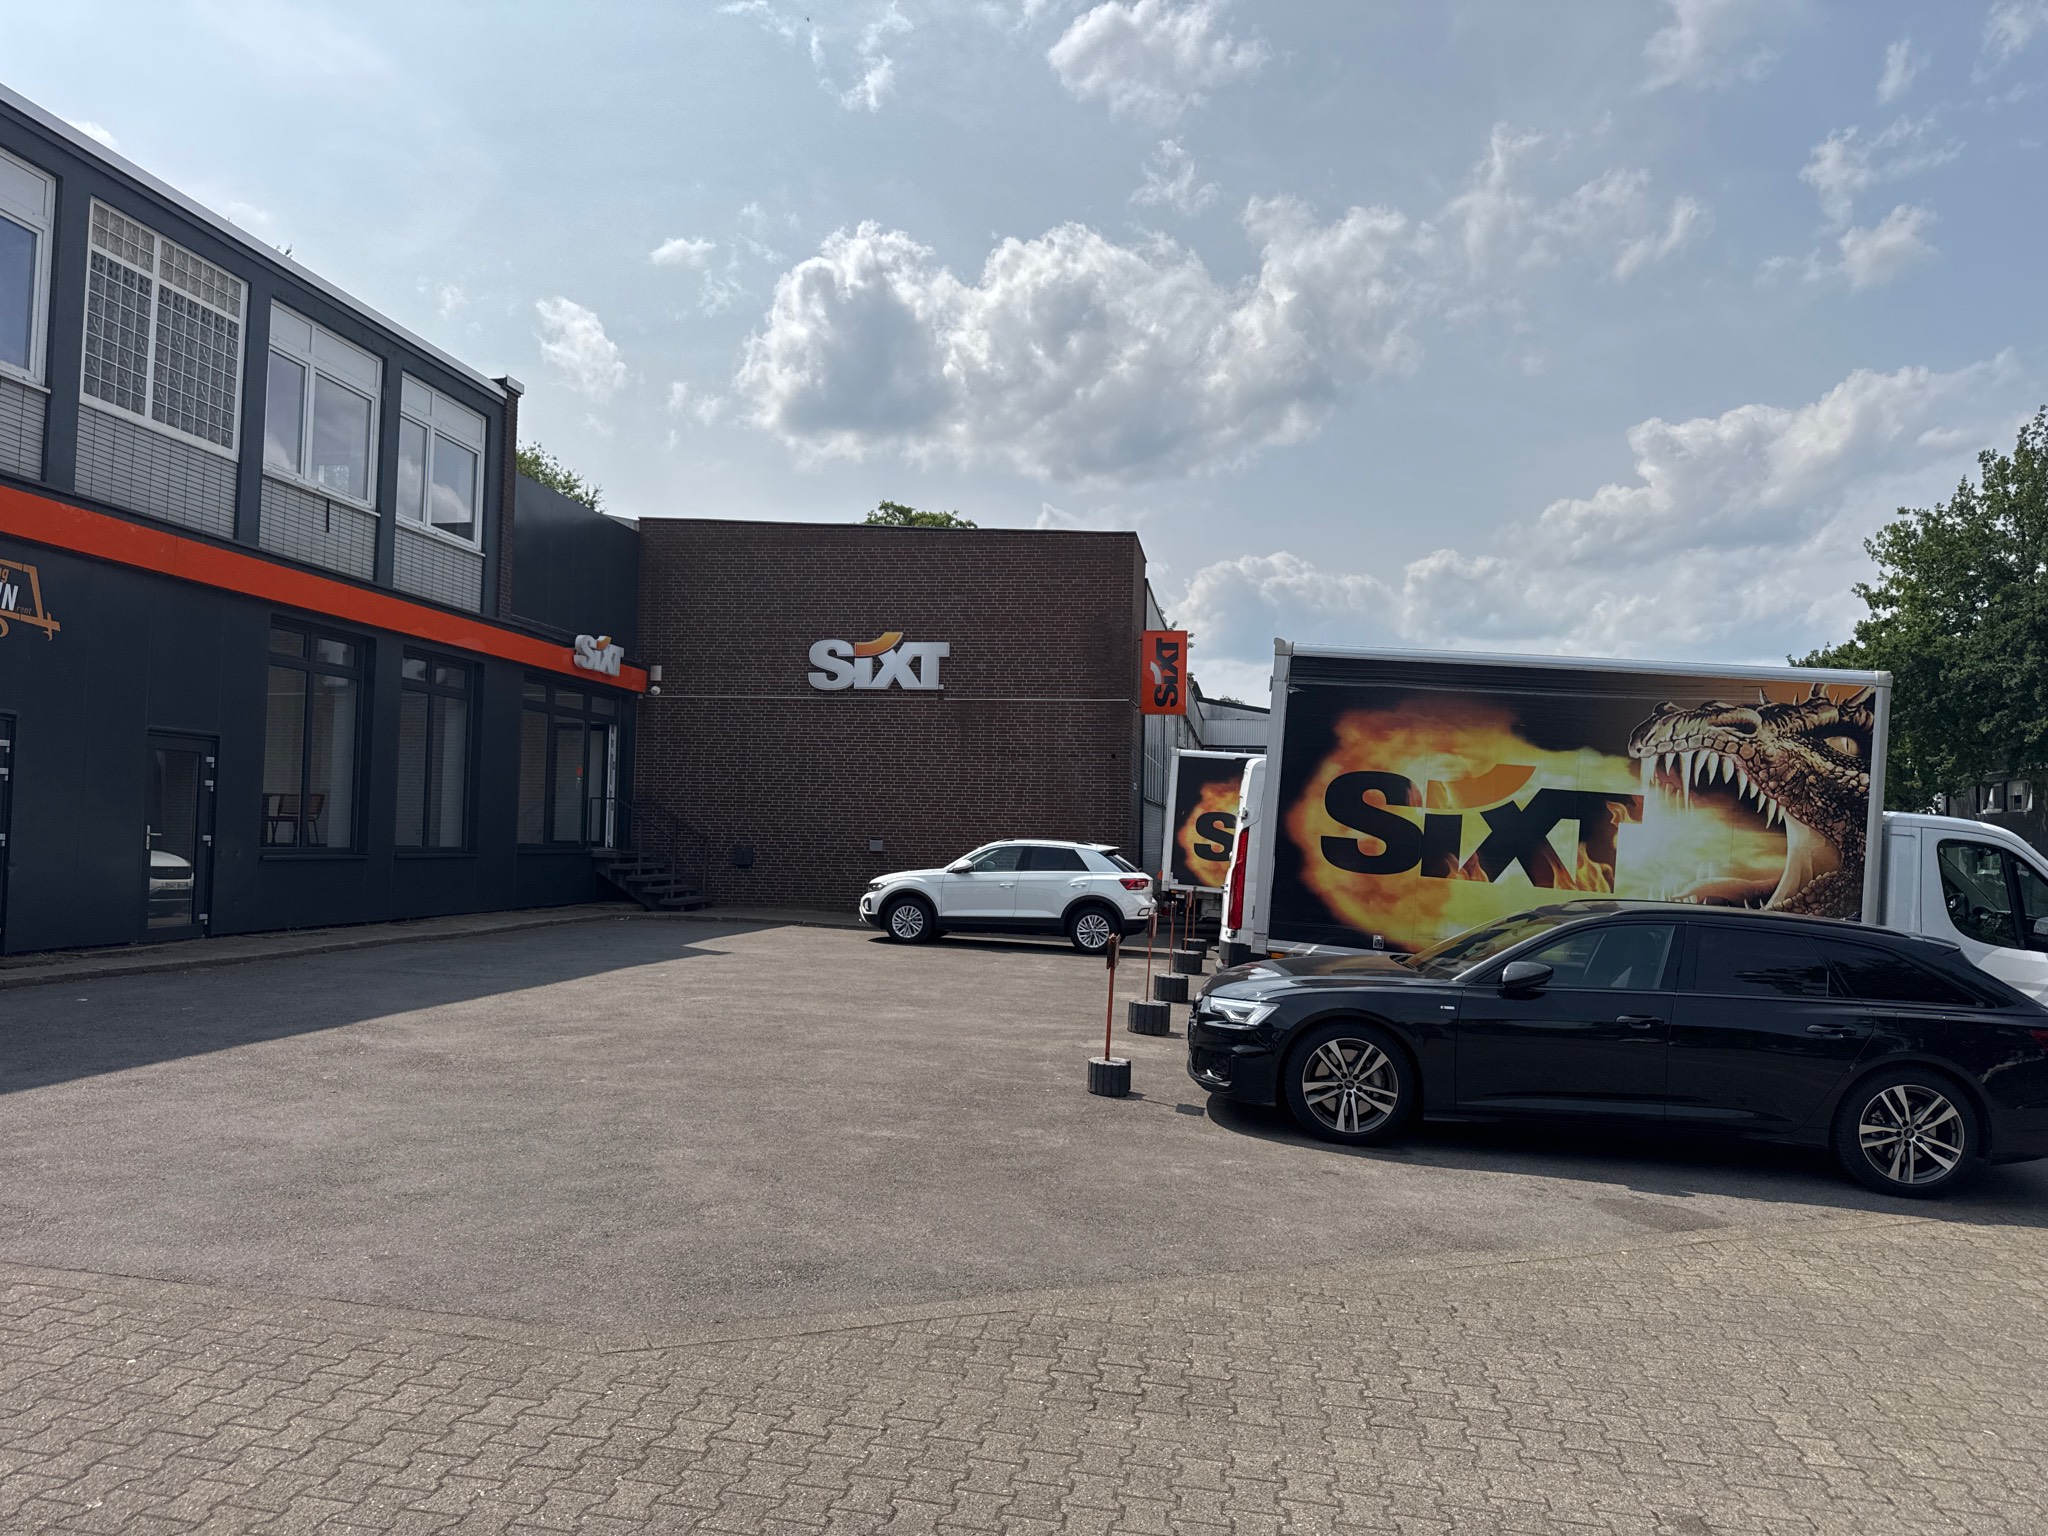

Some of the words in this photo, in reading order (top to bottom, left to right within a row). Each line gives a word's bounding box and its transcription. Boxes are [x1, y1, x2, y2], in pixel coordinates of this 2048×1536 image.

[573, 634, 625, 677] SIXT
[808, 631, 950, 691] SIXT
[1320, 763, 1645, 894] SIXT
